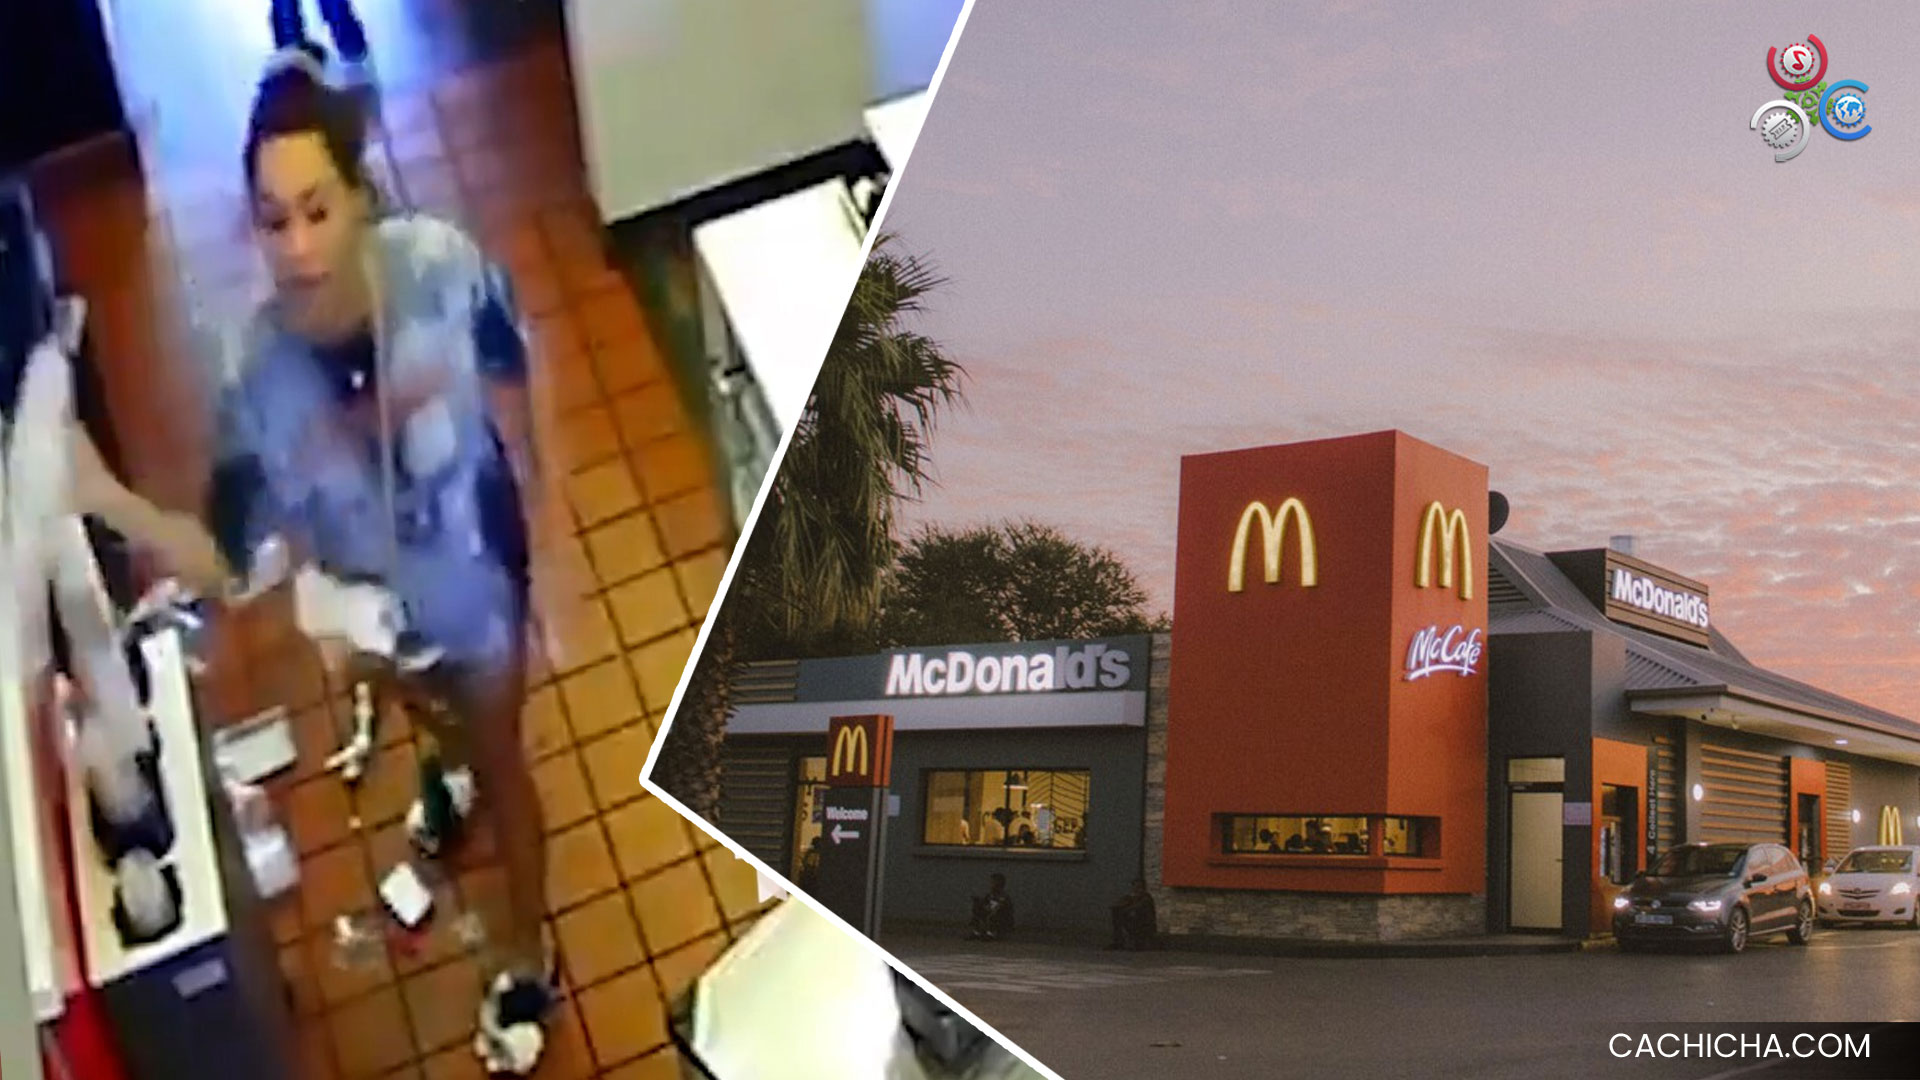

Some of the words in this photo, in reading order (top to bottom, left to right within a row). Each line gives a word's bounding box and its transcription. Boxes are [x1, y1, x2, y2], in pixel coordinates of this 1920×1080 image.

[1613, 568, 1709, 628] McDonald's
[885, 643, 1130, 695] McDonald's
[826, 806, 868, 820] Welcome
